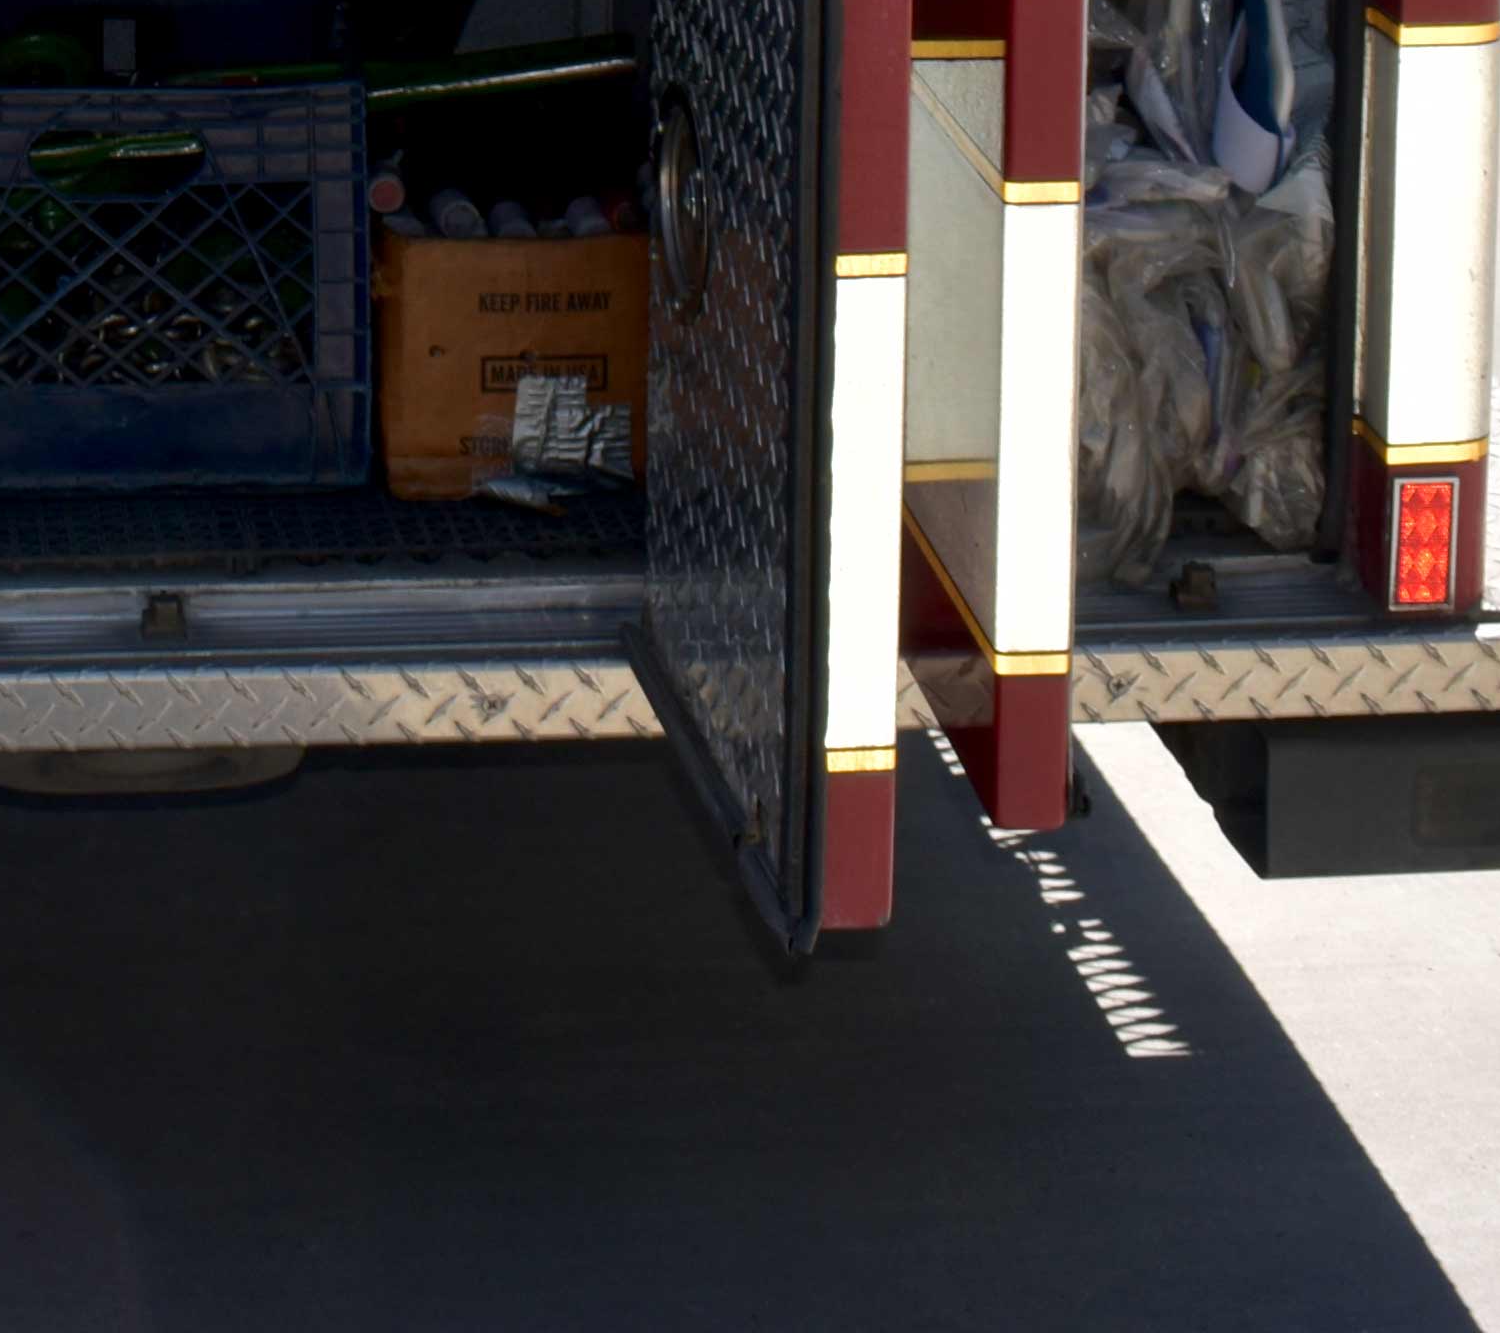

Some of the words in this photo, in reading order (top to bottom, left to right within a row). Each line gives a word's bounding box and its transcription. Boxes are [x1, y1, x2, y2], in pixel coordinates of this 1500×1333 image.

[478, 292, 520, 313] KEEP
[525, 292, 561, 312] FIRE
[567, 291, 612, 311] AWAY
